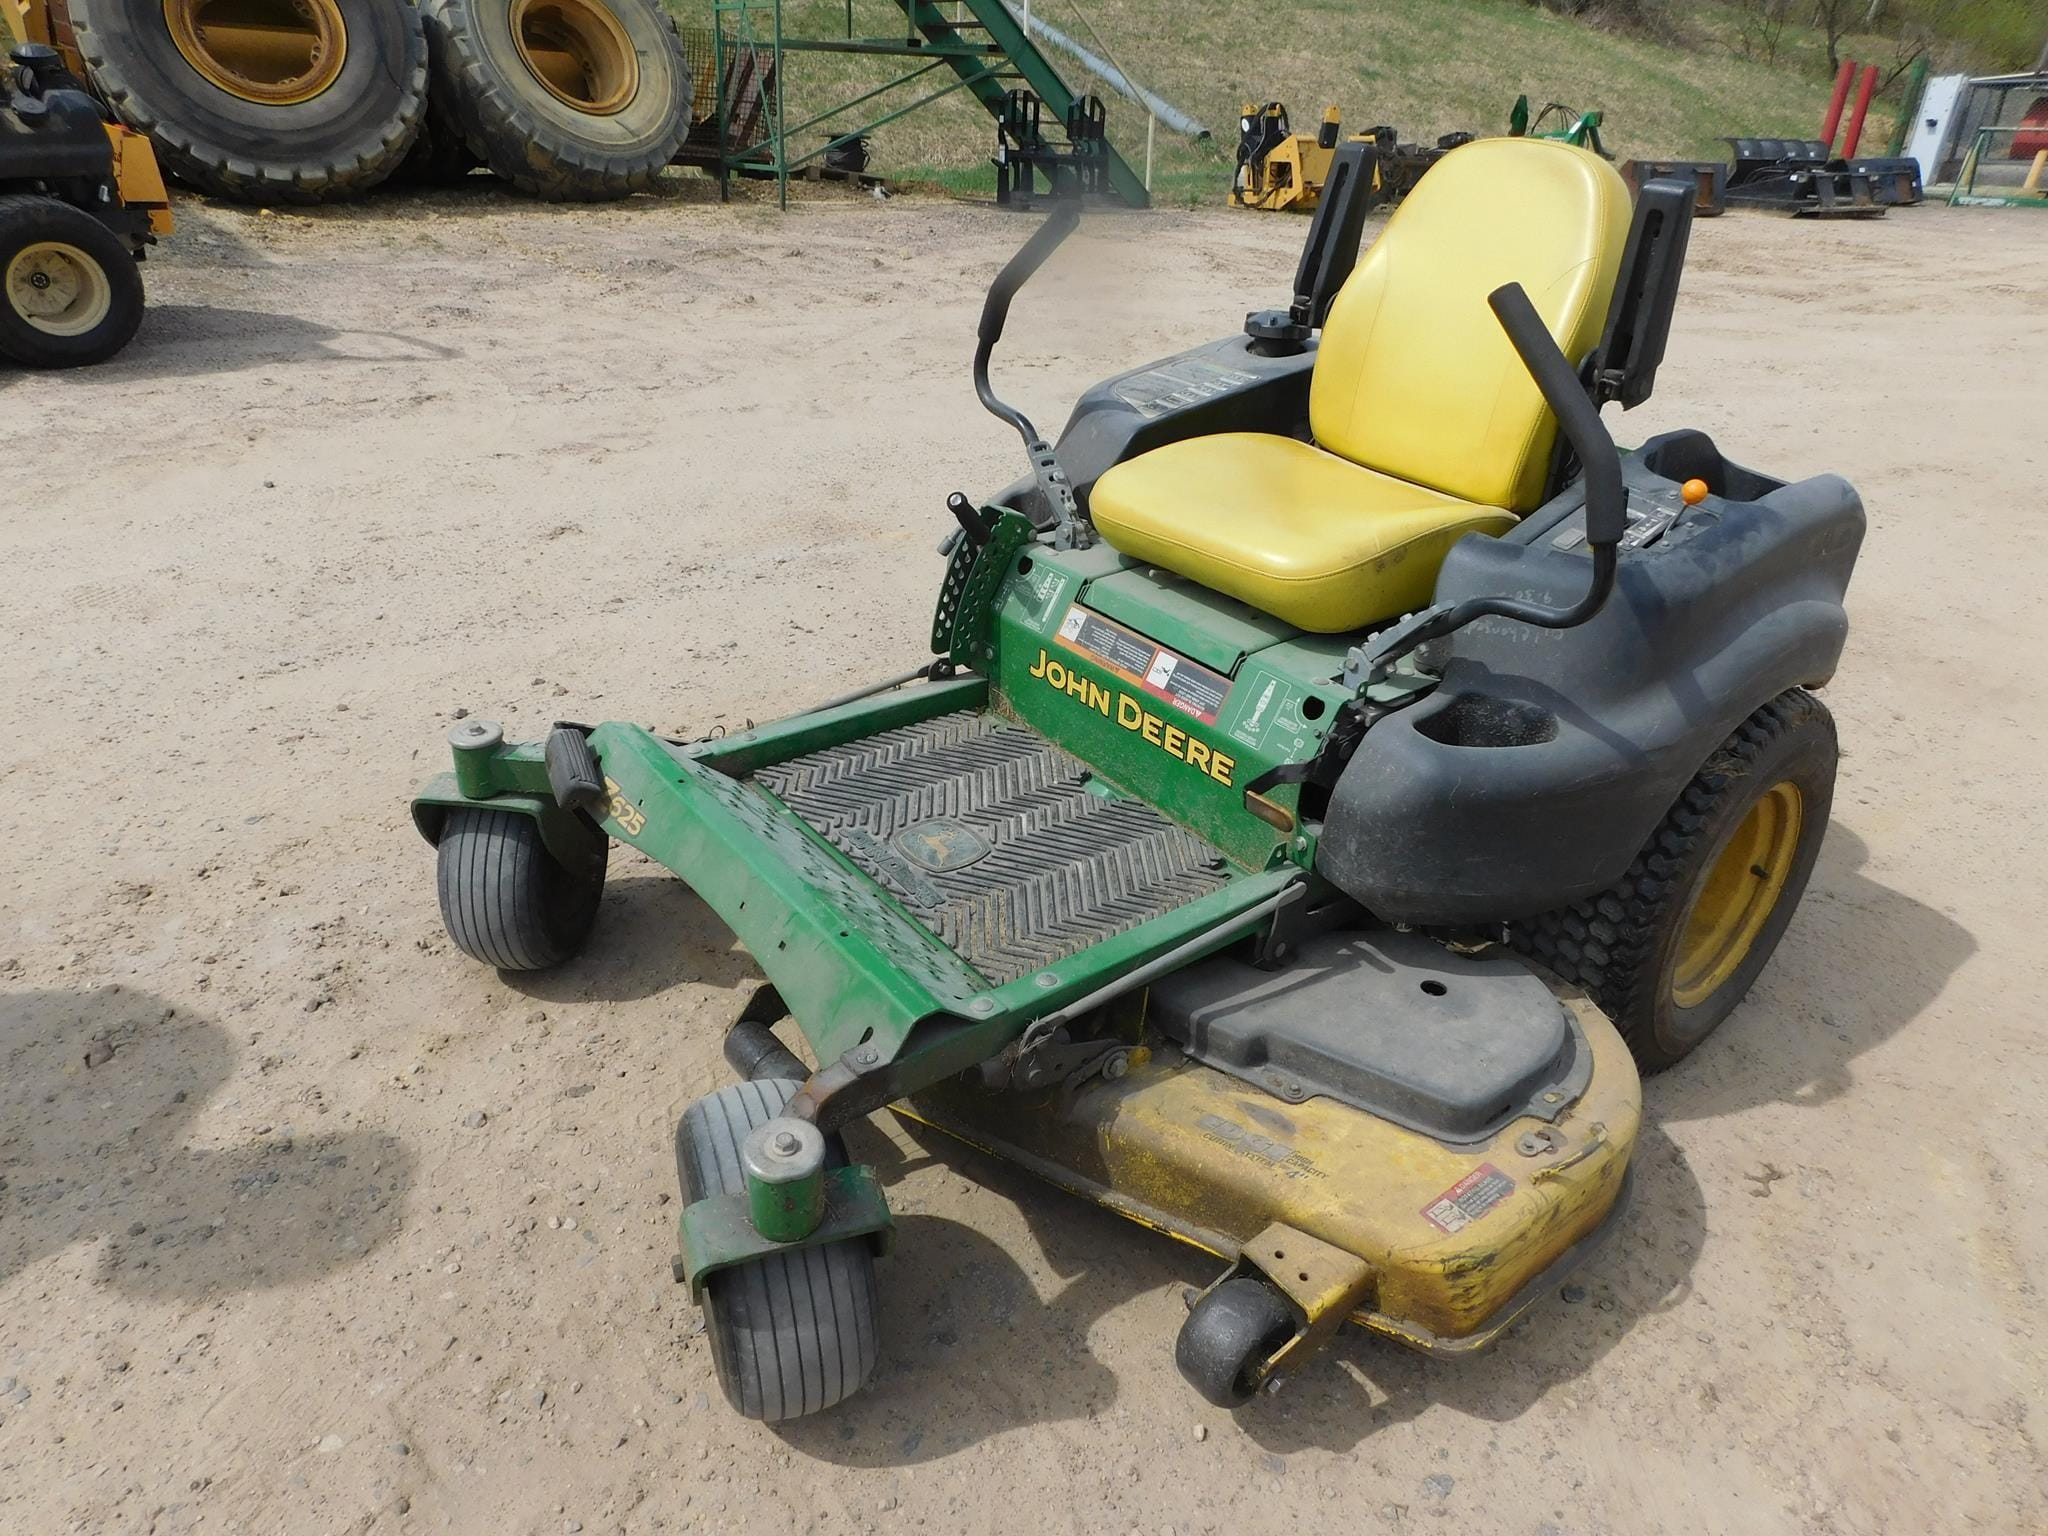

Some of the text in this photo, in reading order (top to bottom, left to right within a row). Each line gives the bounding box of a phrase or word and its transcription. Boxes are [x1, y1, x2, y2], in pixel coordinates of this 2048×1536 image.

[1029, 648, 1112, 718] JOHN
[1116, 691, 1236, 788] DEERE
[1172, 697, 1195, 715] DANGER
